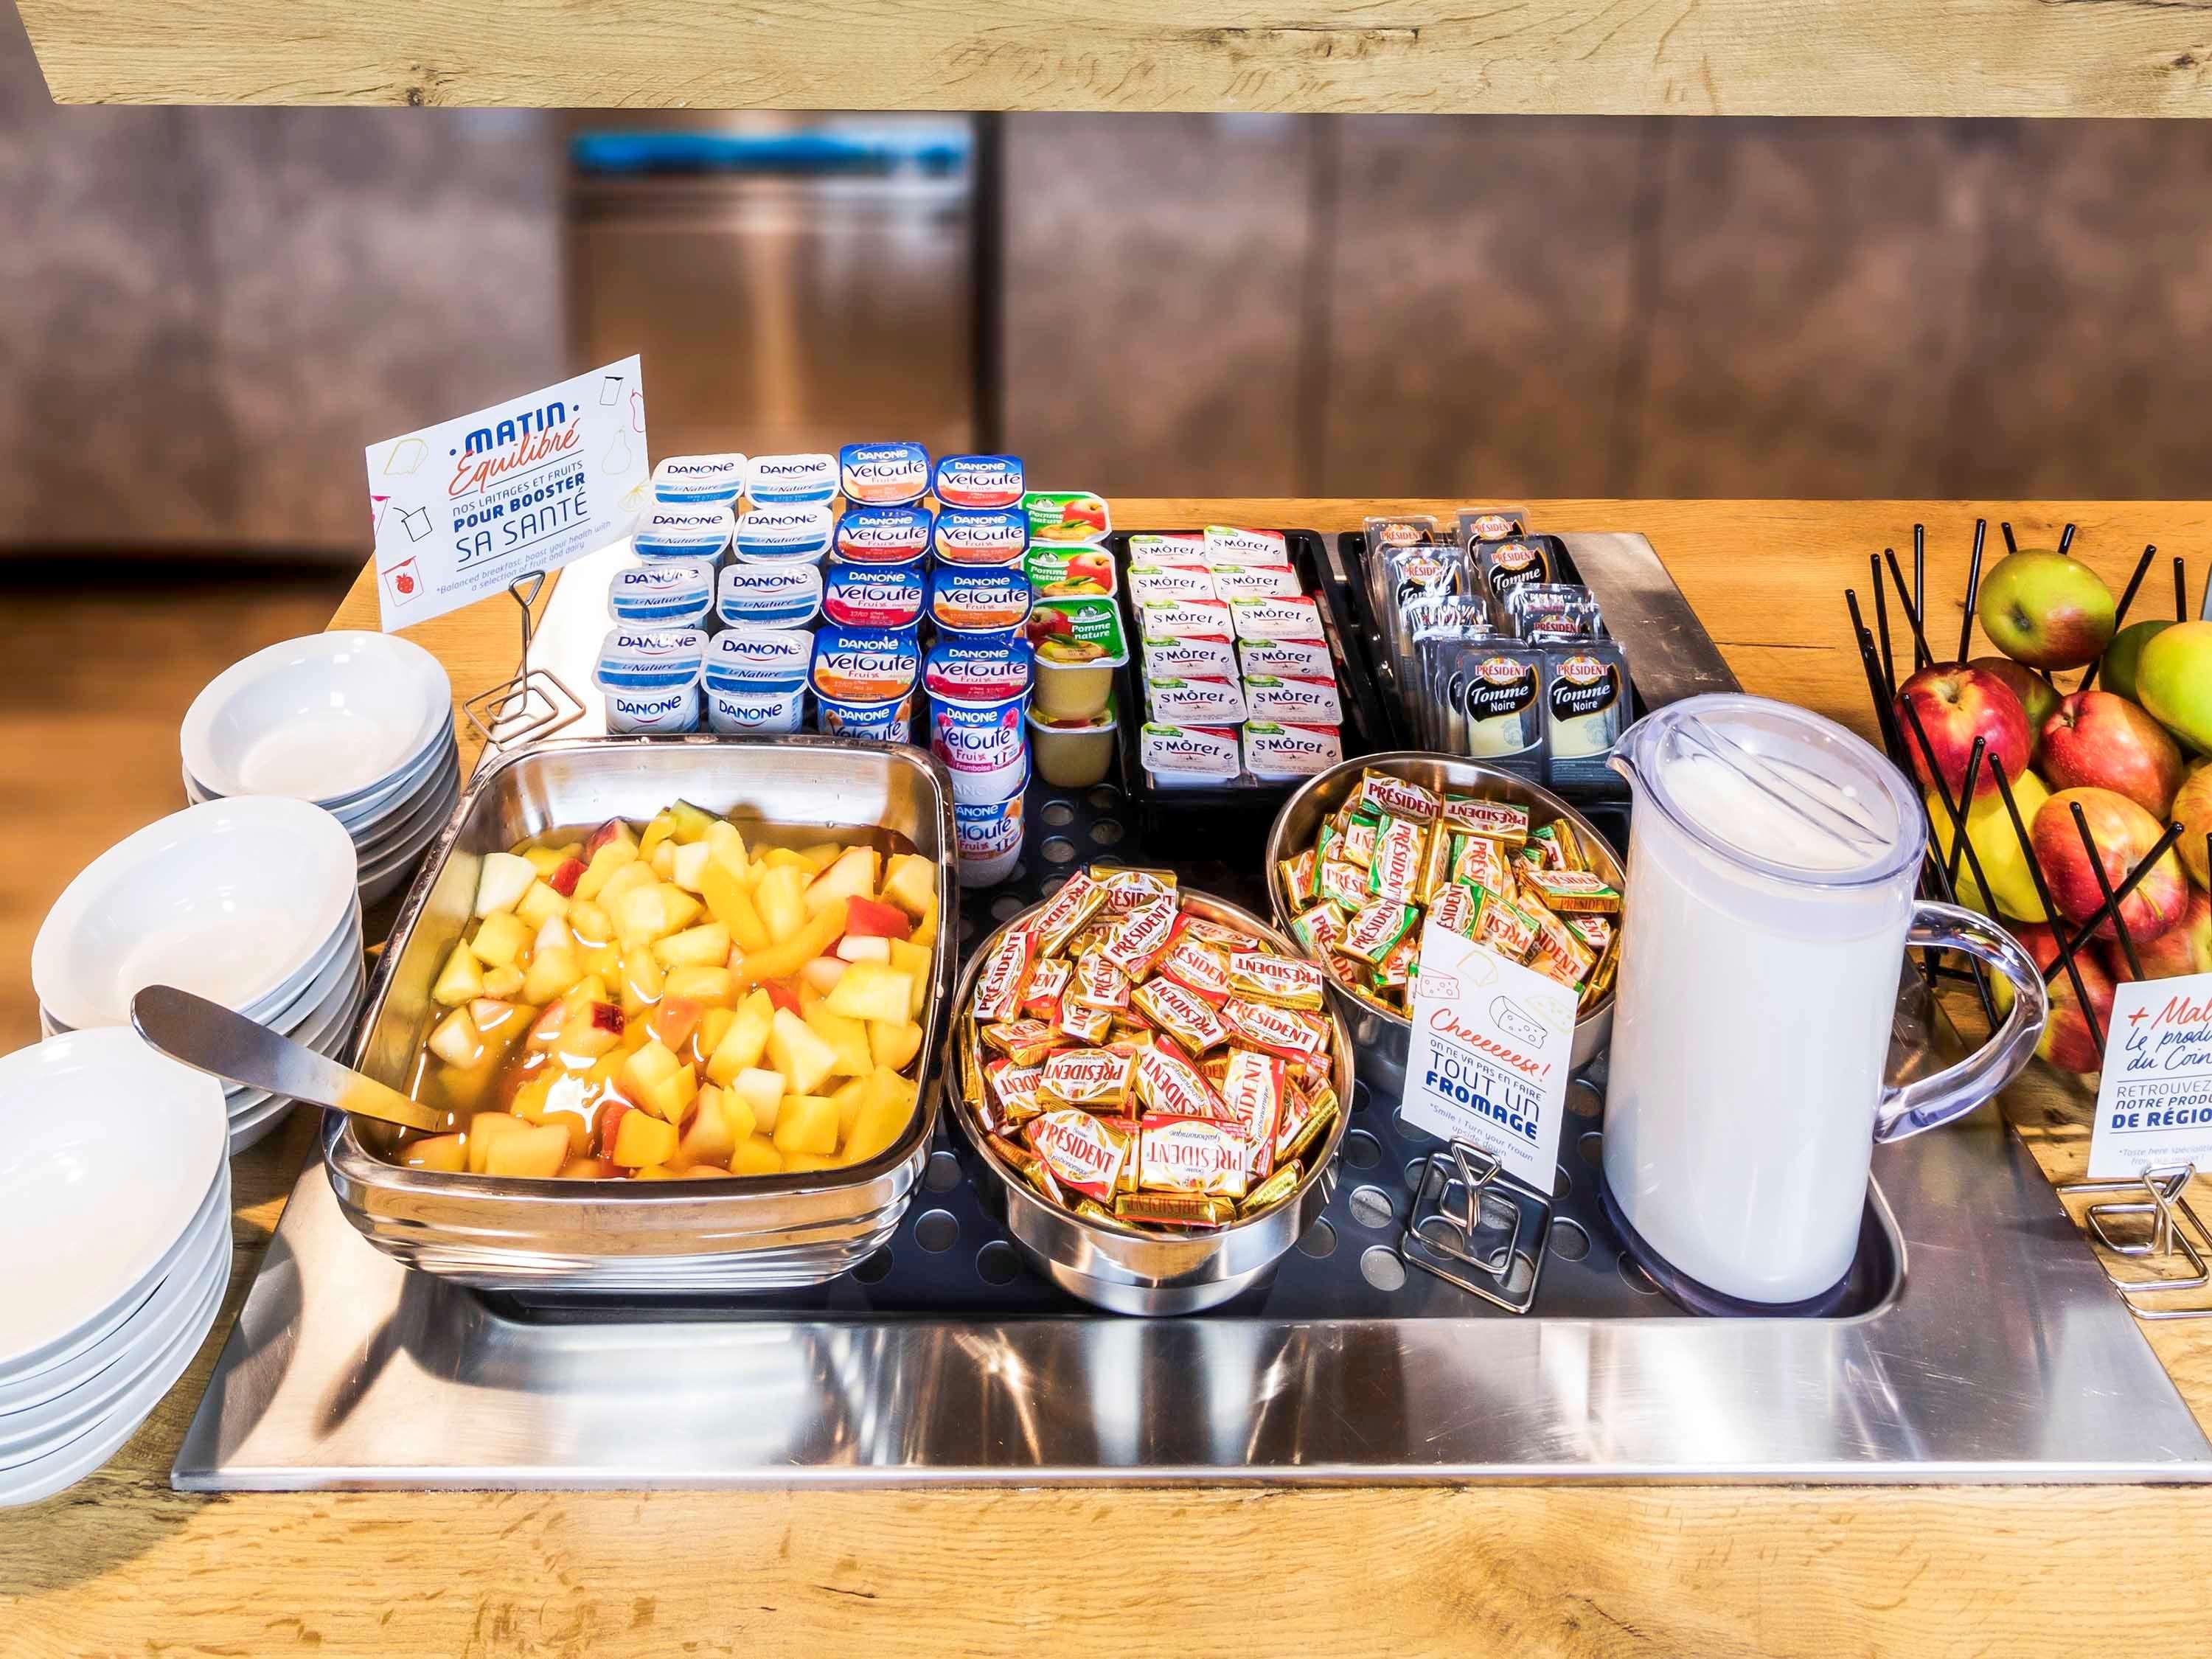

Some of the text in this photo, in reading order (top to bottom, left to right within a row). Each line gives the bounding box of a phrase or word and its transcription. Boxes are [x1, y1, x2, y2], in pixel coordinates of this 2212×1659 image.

[465, 402, 566, 458] MATIN
[479, 482, 529, 507] LAITAGES
[533, 475, 544, 487] ET
[548, 460, 583, 482] FRUITS
[454, 472, 585, 533] POUR BOOSTER
[456, 484, 588, 563] SA SANTÉ
[595, 521, 611, 533] with
[1492, 567, 1541, 590] Tomme
[834, 582, 920, 601] Velouté
[939, 587, 1027, 604] Velouté
[1071, 622, 1110, 633] Pomme
[1074, 630, 1110, 640] nature
[821, 650, 915, 671] Velouté
[933, 660, 1026, 677] Velouté
[1475, 664, 1527, 677] PRÉSIDENT
[1557, 664, 1608, 676] PRÉSIDENT
[1471, 685, 1528, 703] Tomme
[1553, 684, 1610, 704] Tomme
[1491, 700, 1515, 712] Noire
[1573, 700, 1598, 712] Noire
[940, 726, 1010, 749] Velouté
[956, 804, 998, 817] ANONE
[1368, 783, 1441, 821] PRÉSIDENT
[956, 814, 1011, 841] elouté
[1110, 903, 1171, 958] PRÉSIDENT
[978, 934, 1021, 1012] PRÉSIDENT
[1237, 958, 1321, 986] PRÉSIDENT
[1148, 981, 1217, 1038] PRÉSIDENT
[1227, 998, 1313, 1045] PRÉSIDENT
[2126, 1027, 2148, 1051] Le
[2126, 1049, 2158, 1071] du
[1044, 1064, 1124, 1084] PRÉSIDENT
[1430, 1049, 1496, 1096] TOUT
[1461, 1053, 1474, 1068] VA
[1477, 1061, 1495, 1077] PAS
[1514, 1080, 1543, 1102] FAIRE
[2117, 1080, 2211, 1098] RETROUVEZ
[1425, 1070, 1538, 1140] FROMAGE
[1464, 1121, 1483, 1135] Turn
[1486, 1133, 1504, 1145] your
[2112, 1114, 2138, 1129] DE
[1039, 1120, 1115, 1173] PRÉSIDENT
[1149, 1141, 1242, 1172] PRÉSIDENT
